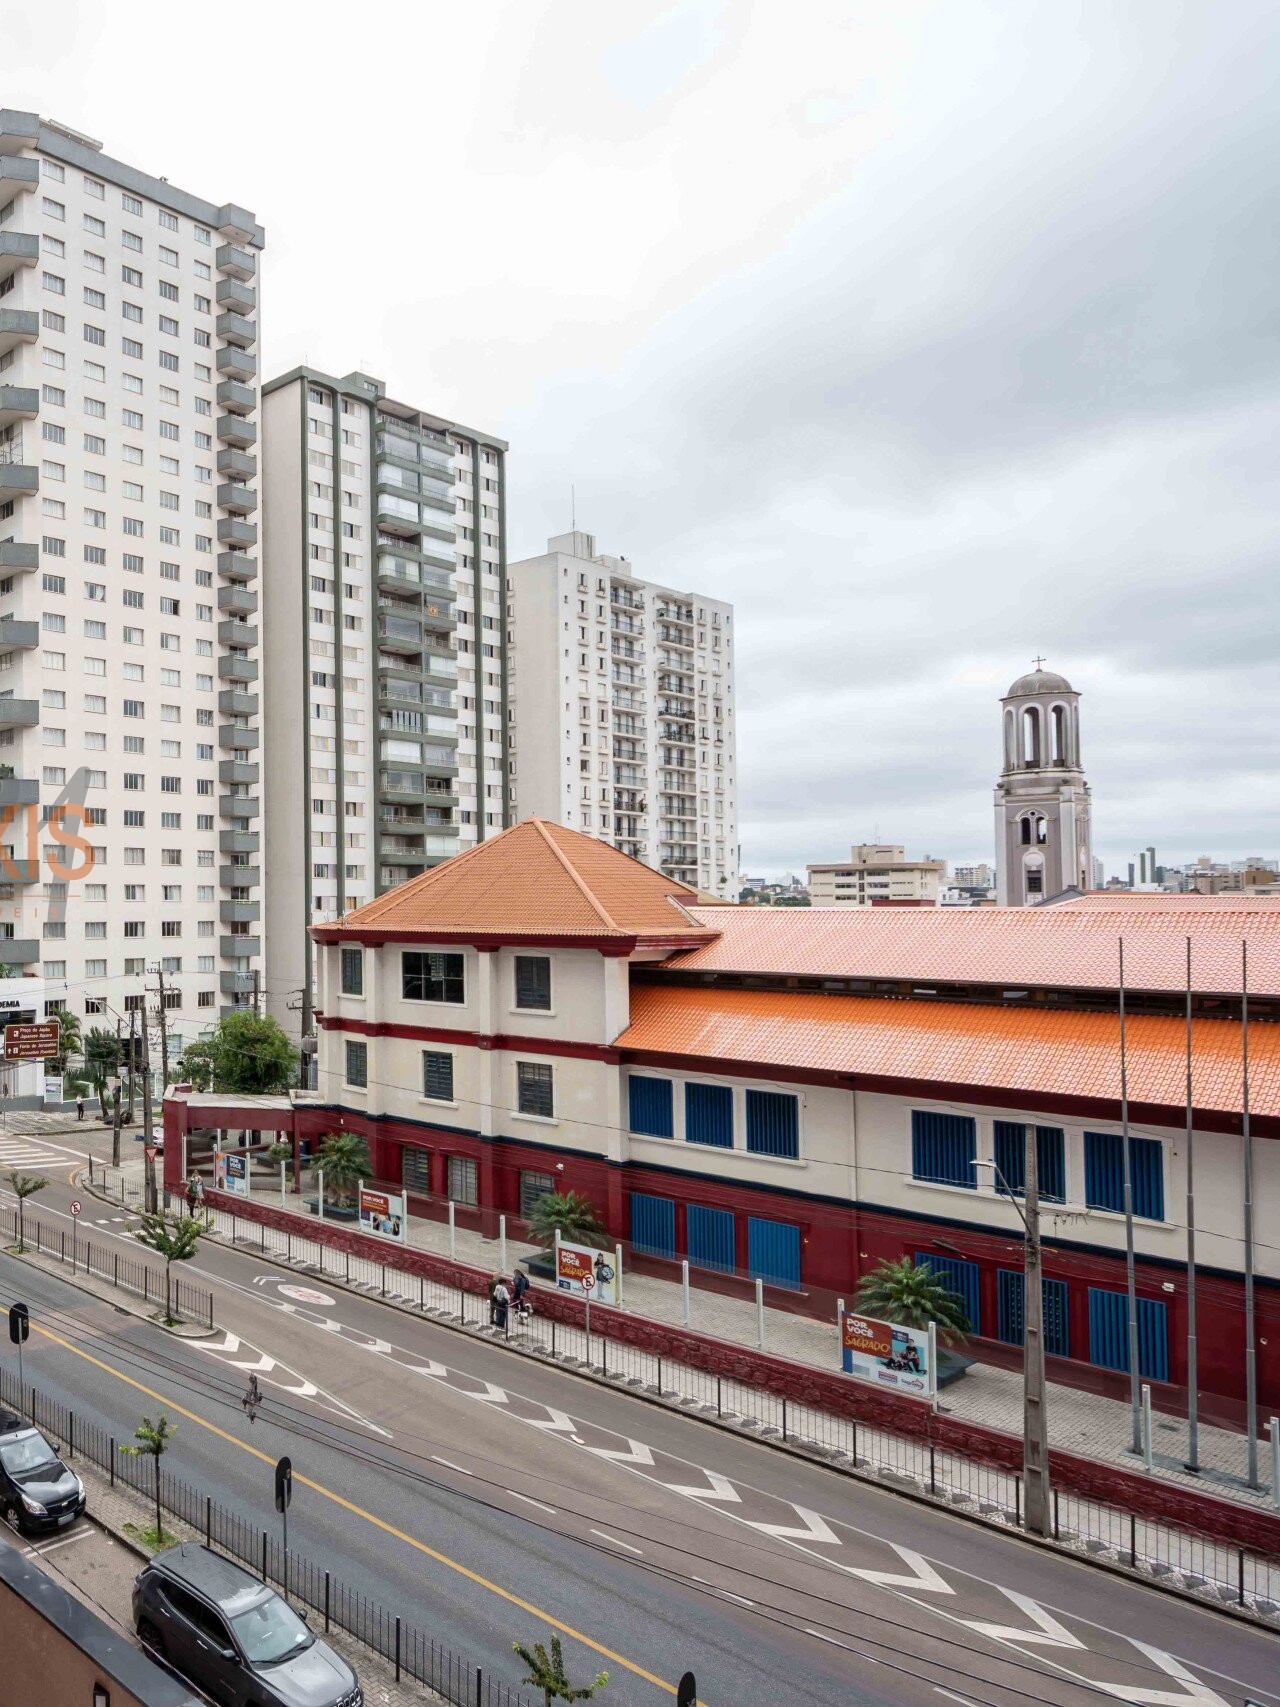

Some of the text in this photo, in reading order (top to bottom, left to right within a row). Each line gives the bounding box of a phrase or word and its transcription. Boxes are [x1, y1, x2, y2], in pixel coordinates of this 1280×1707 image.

[561, 1251, 576, 1259] POR
[561, 1256, 580, 1267] VOCÊ
[846, 1318, 869, 1330] POR
[846, 1324, 874, 1338] VOCÊ
[845, 1335, 890, 1353] SAGRADO
